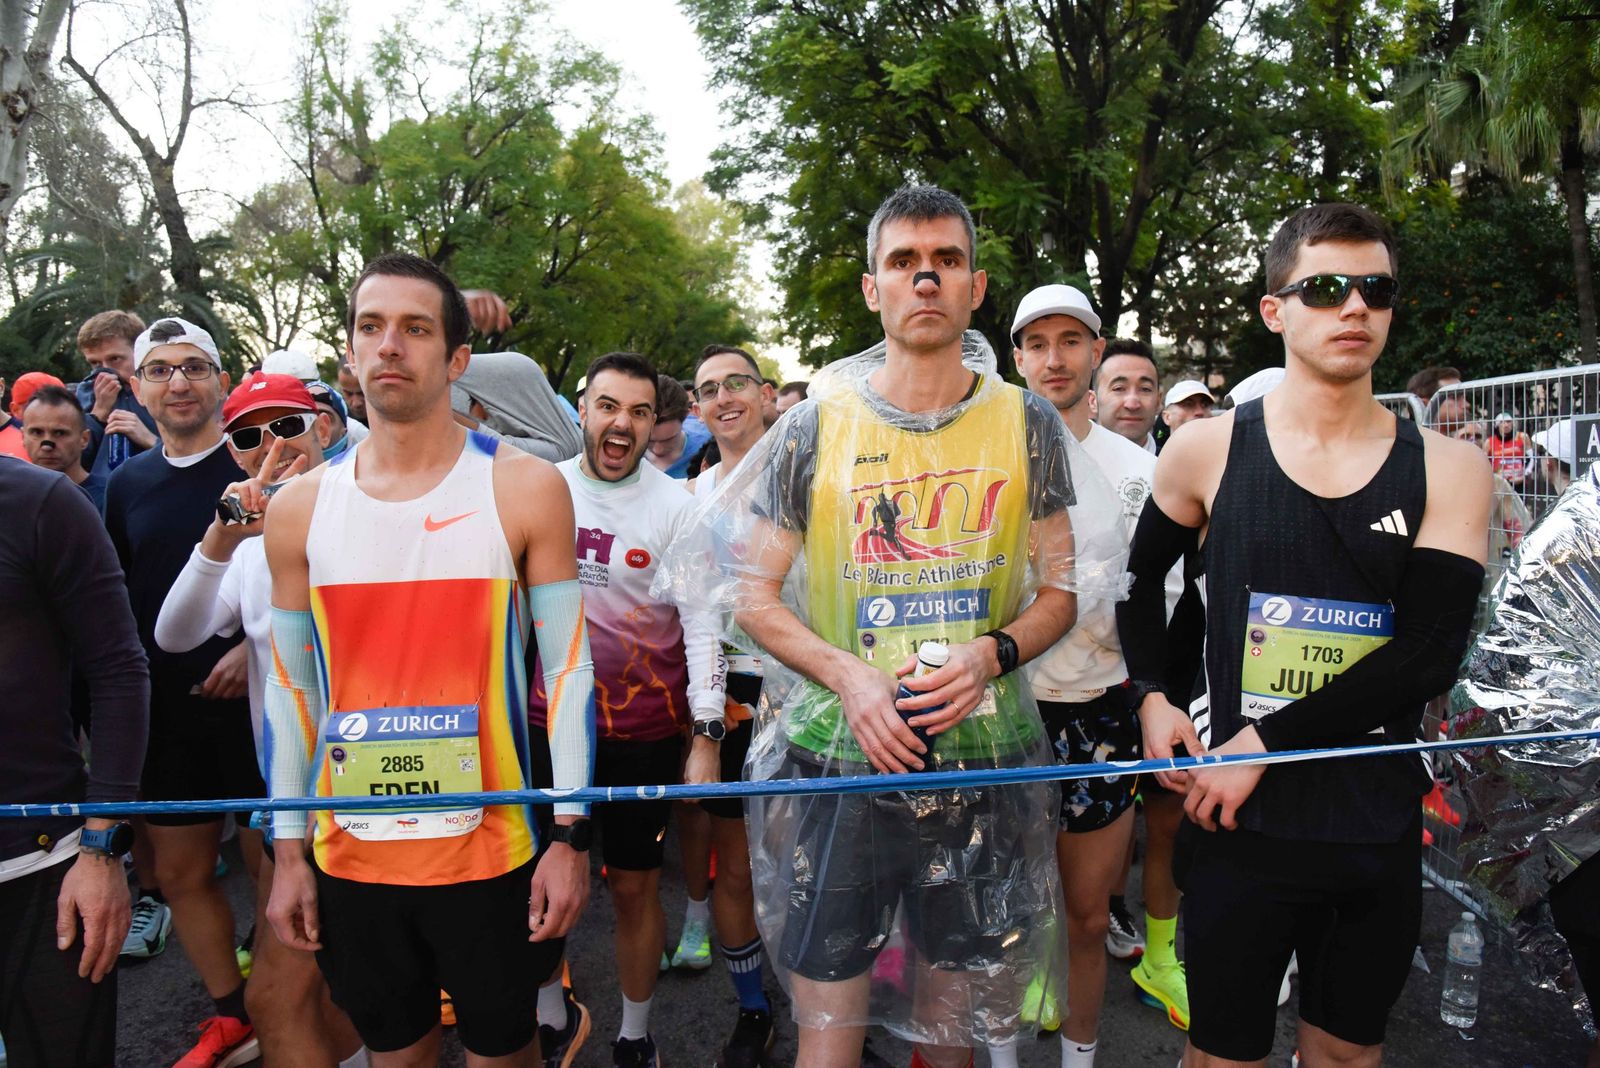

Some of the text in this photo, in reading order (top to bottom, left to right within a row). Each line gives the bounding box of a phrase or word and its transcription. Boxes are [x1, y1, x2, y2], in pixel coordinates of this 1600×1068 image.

[583, 563, 609, 574] MEDIA
[843, 553, 1006, 585] Le Blanc Athlétisme
[905, 597, 980, 618] ZURICH
[1301, 606, 1382, 629] ZURICH
[1301, 645, 1344, 664] 1703
[377, 714, 459, 732] ZURICH
[380, 755, 424, 773] 2885
